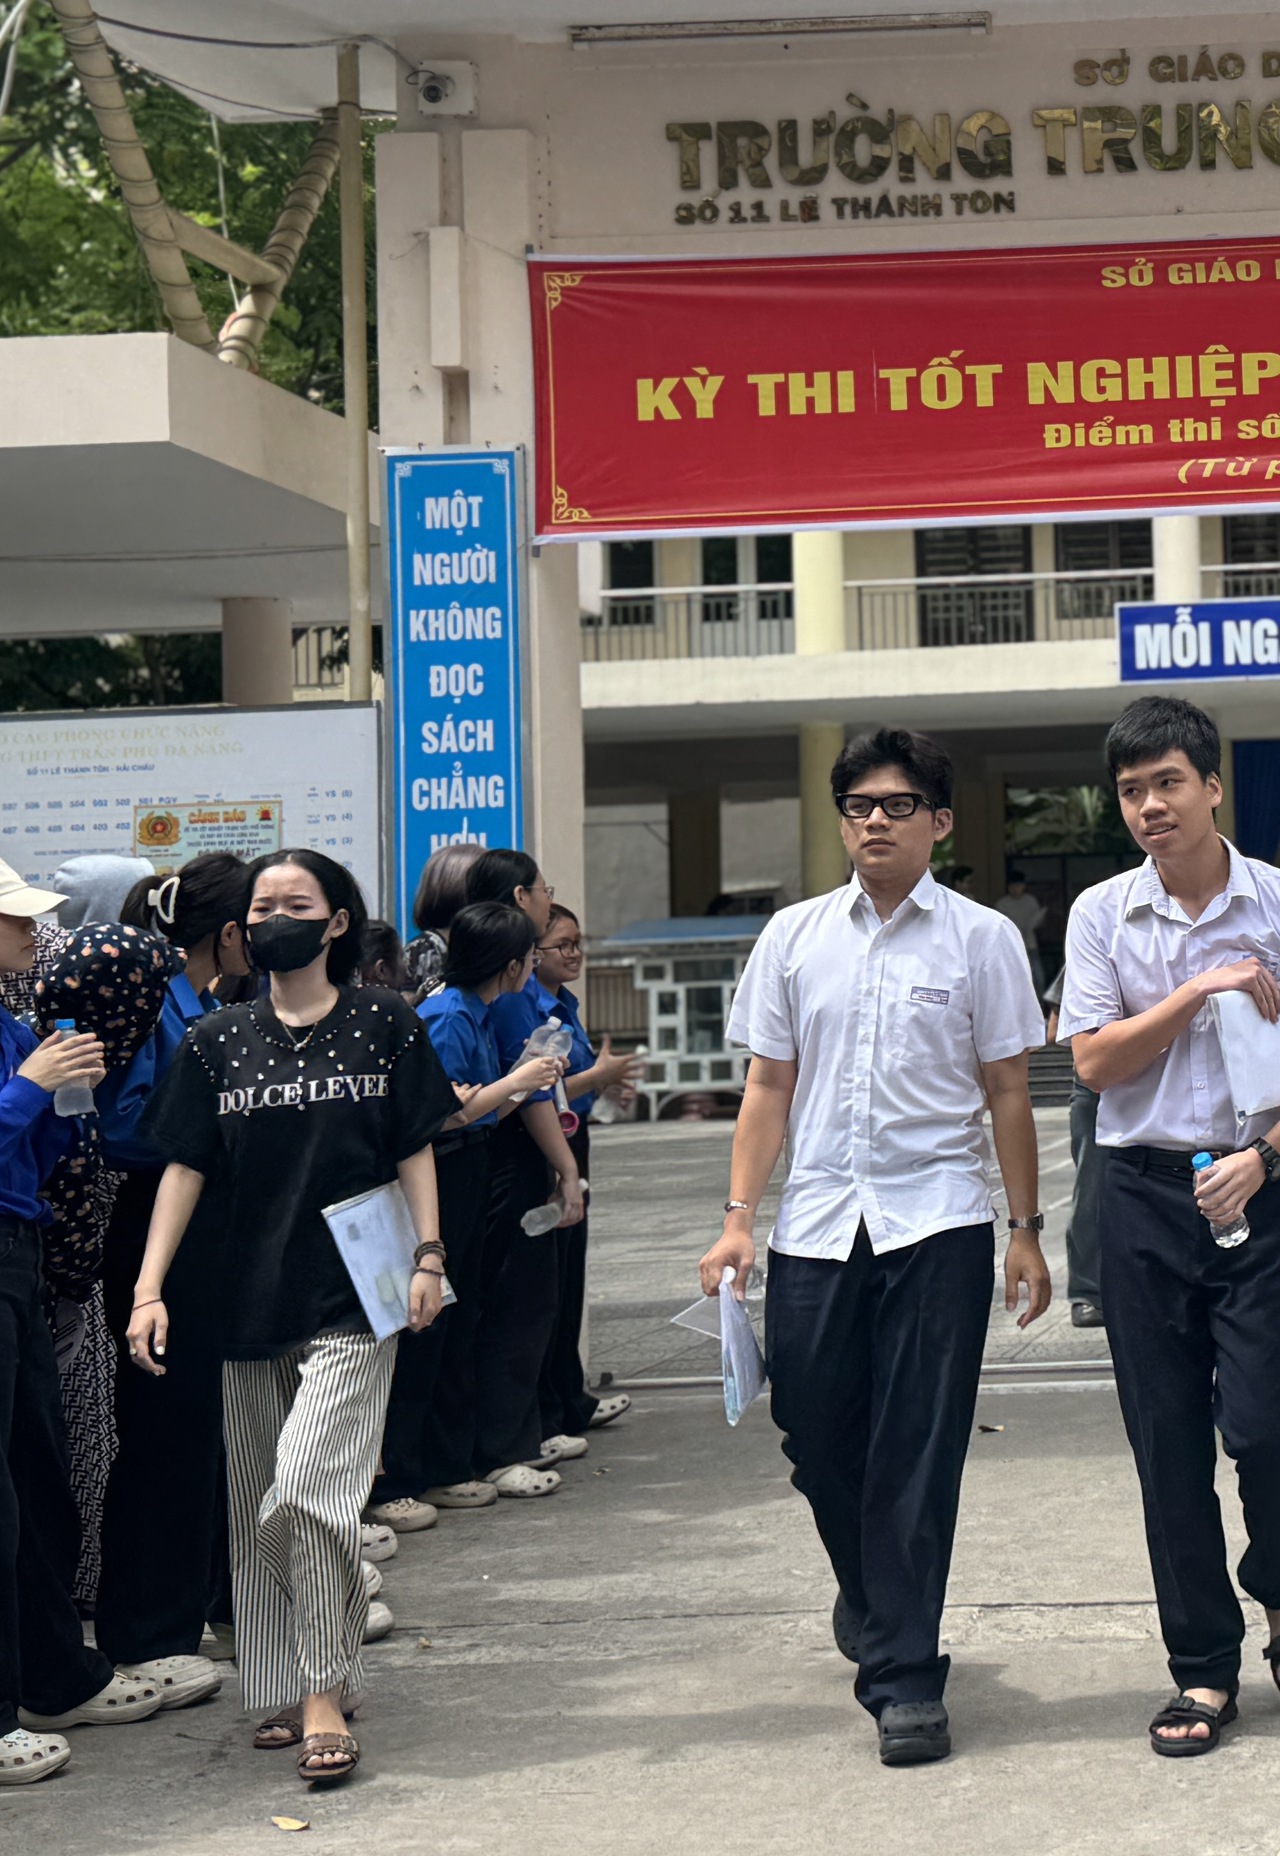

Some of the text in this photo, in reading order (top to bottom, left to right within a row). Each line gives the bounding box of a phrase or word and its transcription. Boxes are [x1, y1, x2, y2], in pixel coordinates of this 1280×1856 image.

[1149, 45, 1246, 84] GIÁO
[665, 92, 1014, 191] TRƯỜNG
[727, 200, 771, 225] 11
[1101, 257, 1155, 288] SỞ
[1167, 255, 1262, 286] GIÁO
[636, 366, 726, 422] KỲ
[747, 370, 856, 418] THI
[879, 349, 1004, 412] TỐT
[1043, 415, 1154, 449] Điểm
[1168, 417, 1223, 444] thi
[1176, 455, 1260, 485] (Từ
[424, 489, 484, 536] MỘT
[412, 543, 497, 586] NGƯỜI
[409, 601, 503, 642] KHÔNG
[1133, 606, 1212, 670] MỖI
[428, 664, 484, 704] ĐỌC
[421, 714, 495, 755] SÁCH
[411, 760, 505, 811] CHẲNG
[217, 1082, 301, 1116] DOLCE
